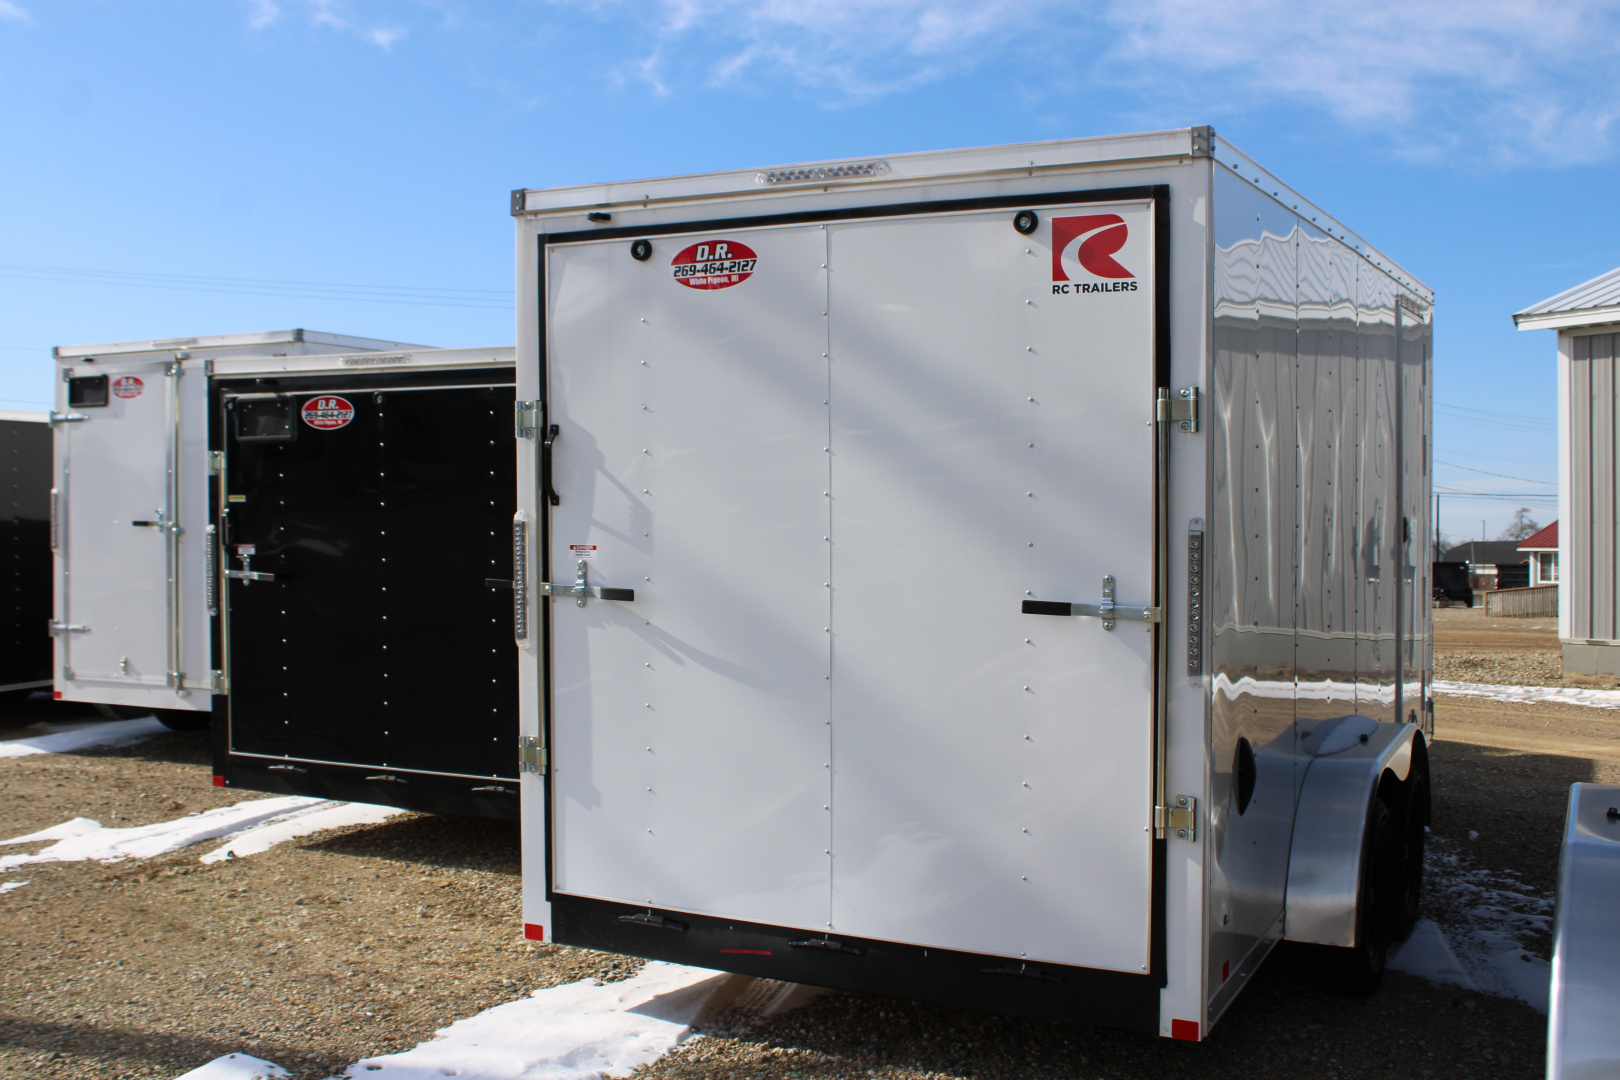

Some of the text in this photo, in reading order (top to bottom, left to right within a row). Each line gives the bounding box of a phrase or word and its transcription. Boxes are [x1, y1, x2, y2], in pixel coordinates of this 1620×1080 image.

[695, 242, 733, 261] D.R.
[673, 259, 757, 277] 269-464-2127
[689, 274, 739, 286] White Pigeon, MI
[1052, 281, 1138, 295] RC TRAILERS
[317, 399, 340, 410] D.R.
[304, 410, 353, 419] 269-464-2127
